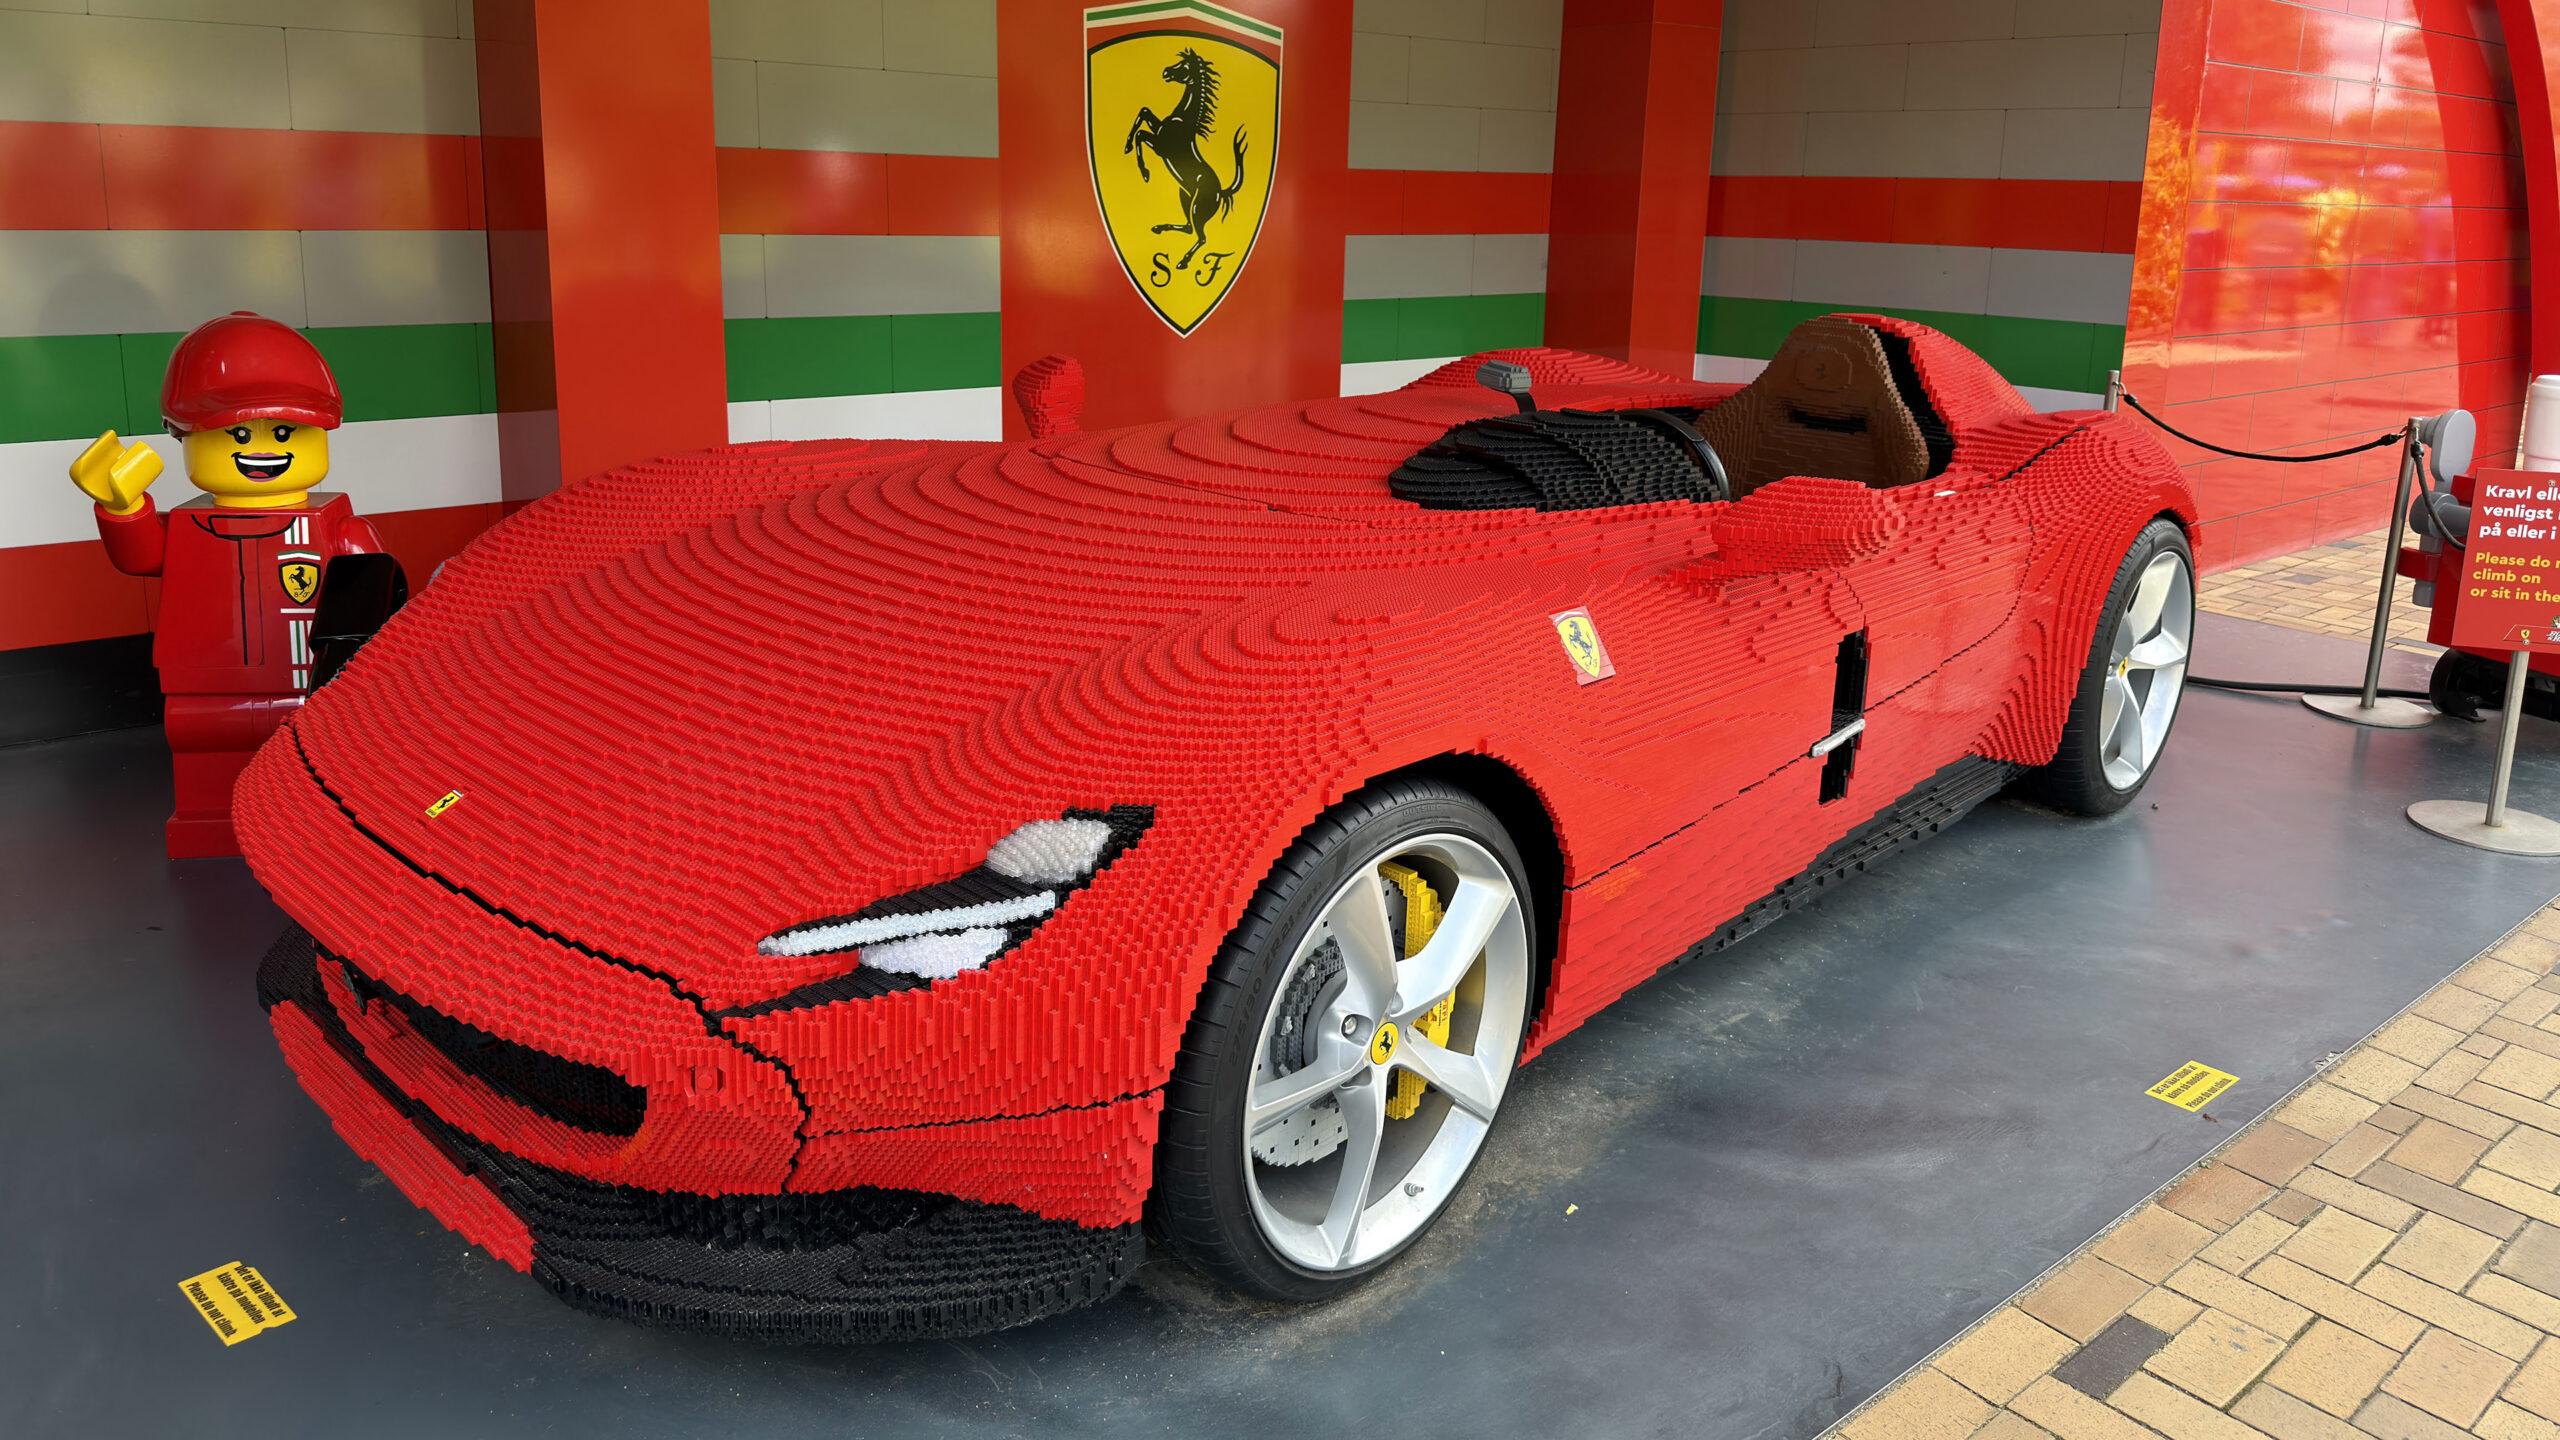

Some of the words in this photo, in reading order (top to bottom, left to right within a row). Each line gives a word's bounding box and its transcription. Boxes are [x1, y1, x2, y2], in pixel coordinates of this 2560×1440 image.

[1150, 252, 1171, 288] S
[1195, 251, 1235, 287] F
[2486, 485, 2532, 499] Kravl
[2536, 487, 2560, 501] ell
[2483, 504, 2553, 521] venligst
[2479, 522, 2501, 538] på
[2506, 524, 2546, 539] eller
[2550, 526, 2557, 540] i
[2475, 552, 2525, 566] Please
[2530, 555, 2551, 568] do
[2473, 568, 2517, 582] climb
[2521, 574, 2541, 584] on
[2470, 588, 2487, 597] or
[2491, 586, 2511, 599] sit
[2515, 587, 2530, 600] in
[2534, 590, 2560, 602] the
[186, 1281, 209, 1303] Please
[201, 1300, 216, 1310] do
[207, 1308, 225, 1320] not
